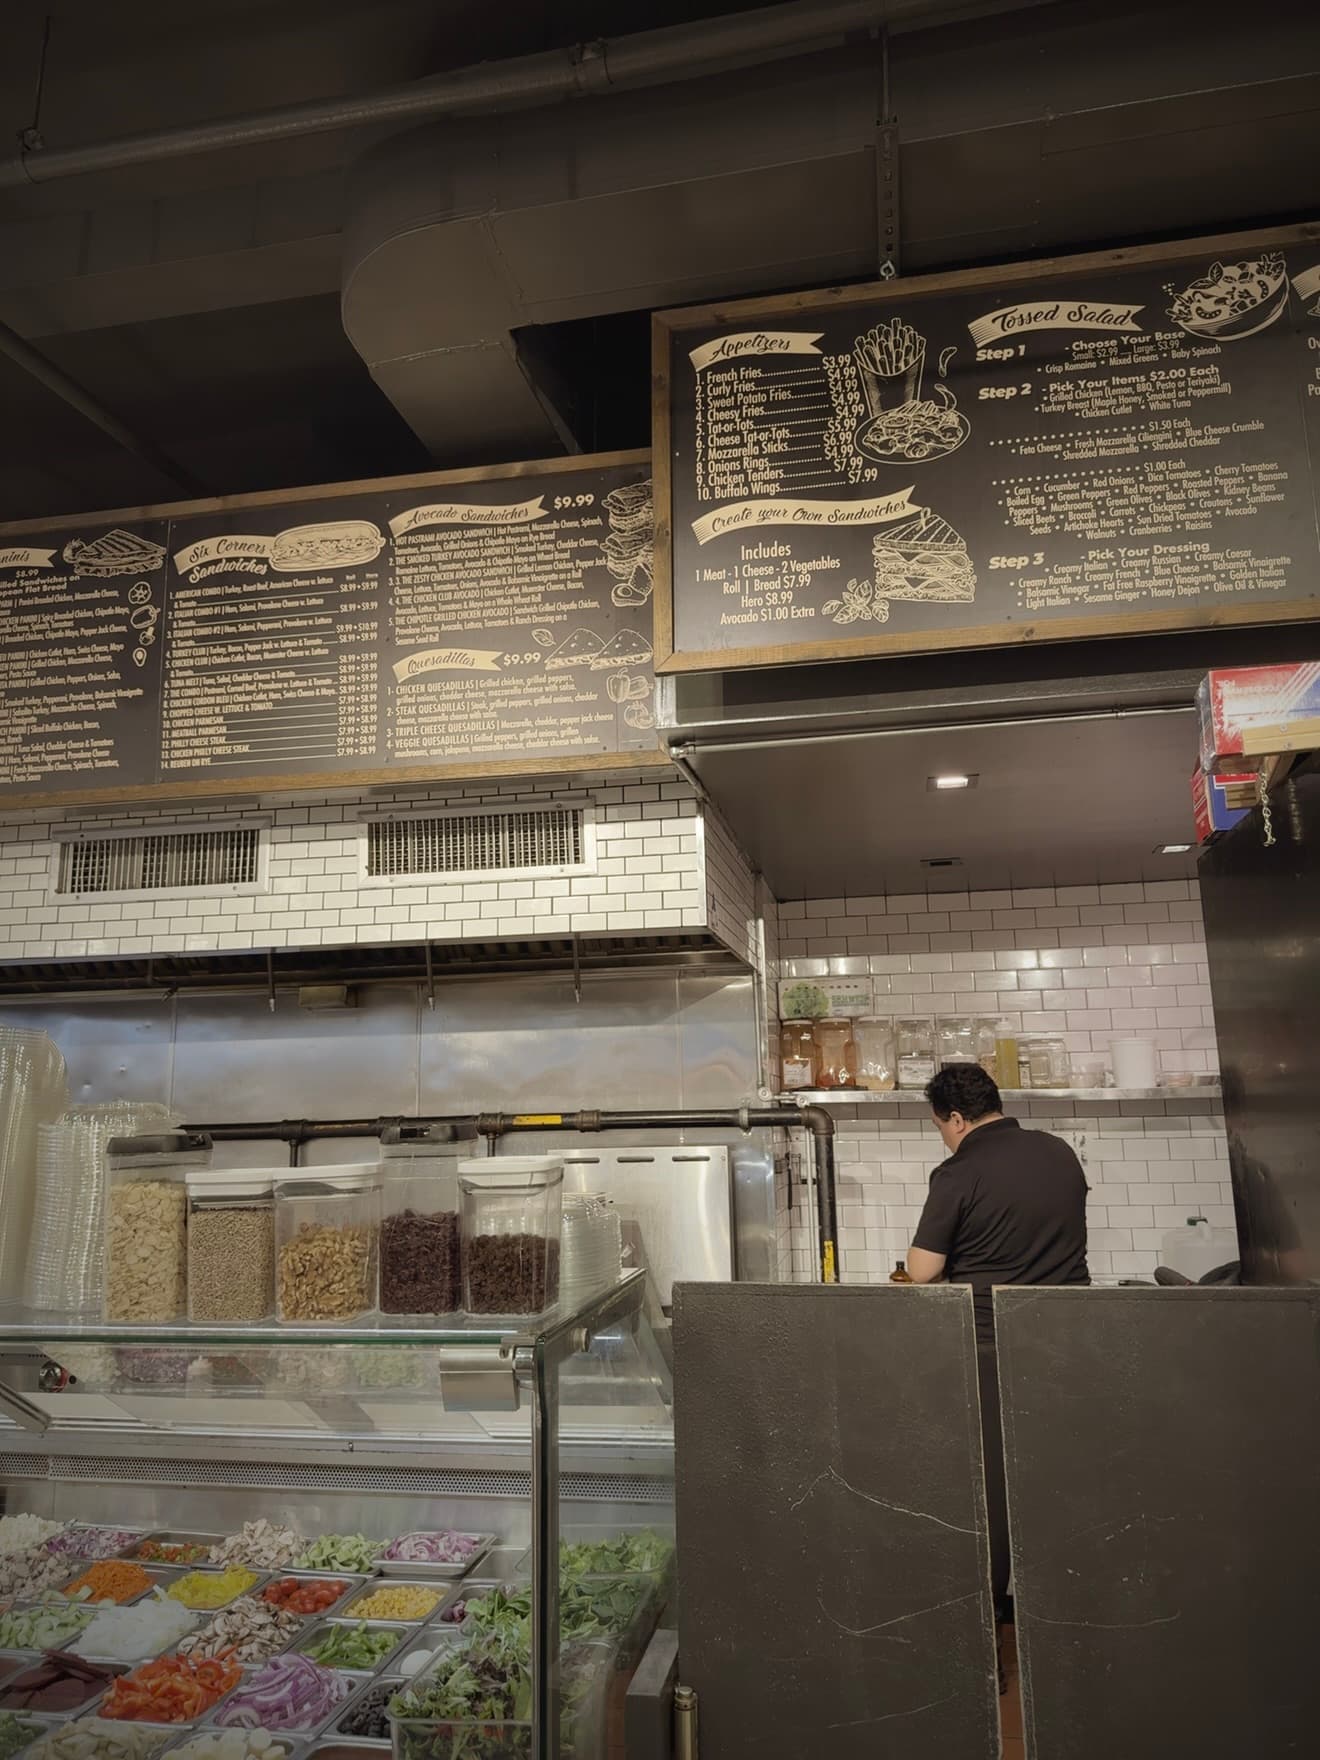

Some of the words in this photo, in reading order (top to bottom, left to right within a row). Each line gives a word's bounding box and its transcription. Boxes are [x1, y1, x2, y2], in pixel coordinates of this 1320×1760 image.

[991, 304, 1060, 332] Tossed
[1067, 304, 1132, 326] Salad
[709, 334, 790, 362] Appetizers
[1072, 335, 1117, 351] Choose
[1121, 331, 1151, 345] Your
[1155, 326, 1186, 342] Base
[1097, 345, 1118, 360] $2.99
[1158, 338, 1179, 353] $3.99
[976, 347, 1014, 363] Step
[1017, 344, 1026, 358] 1
[1045, 363, 1063, 375] Crisp
[1065, 357, 1096, 371] Romaine
[1109, 353, 1132, 366] Mixed
[1133, 350, 1160, 363] Greens
[1171, 347, 1191, 361] Baby
[1192, 344, 1221, 359] Spinach
[696, 372, 704, 385] 1.
[707, 368, 738, 383] French
[740, 366, 763, 379] Fries
[822, 353, 850, 370] $3.99
[1050, 380, 1074, 394] Pick
[1077, 376, 1108, 391] Your
[1112, 371, 1146, 386] Items
[1149, 367, 1186, 384] $2.00
[1190, 363, 1219, 377] Each
[696, 385, 704, 398] 2.
[707, 381, 731, 399] Curly
[734, 378, 757, 393] Fries
[827, 365, 857, 384] $4.99
[978, 385, 1016, 401] Step
[1019, 383, 1032, 397] 2
[696, 396, 704, 410] 3.
[707, 393, 736, 409] Sweet
[738, 389, 767, 405] Potato
[769, 386, 793, 401] Fries
[829, 378, 858, 396] $4.99
[696, 409, 704, 422] 4.
[707, 405, 740, 424] Cheesy
[743, 402, 766, 417] Fries
[831, 391, 861, 409] $4.99
[1081, 404, 1111, 418] Chicken
[1111, 402, 1133, 415] Cutlet
[1149, 398, 1172, 411] White
[1172, 396, 1191, 408] Tuna
[696, 424, 704, 436] 5.
[834, 404, 864, 422] $4.99
[1148, 419, 1170, 434] $1.50
[1171, 417, 1192, 429] Each
[696, 435, 705, 448] 6.
[708, 430, 740, 447] Cheese
[827, 416, 857, 435] $5.99
[1185, 427, 1202, 439] Blue
[1203, 424, 1230, 437] Cheese
[696, 448, 705, 462] 7.
[708, 441, 759, 460] Mozzarella
[761, 437, 789, 454] Sticks
[822, 429, 852, 447] $6.99
[696, 461, 705, 475] 8.
[708, 456, 740, 473] Onions
[743, 453, 770, 471] Rings
[824, 442, 854, 461] $4.99
[1144, 460, 1167, 474] $1.00
[1167, 458, 1186, 470] Each
[696, 474, 705, 487] 9.
[708, 469, 745, 486] Chicken
[747, 464, 785, 481] Tenders
[833, 455, 864, 472] $7.99
[1093, 477, 1107, 488] Red
[1109, 475, 1136, 486] Onions
[1214, 464, 1239, 479] Cherry
[1241, 461, 1278, 473] Tomatoes
[697, 487, 712, 501] 10.
[715, 483, 748, 498] Buffalo
[751, 480, 781, 496] Wings
[848, 468, 877, 485] $7.99
[554, 494, 595, 511] $9.99
[405, 507, 458, 528] Avocado
[461, 507, 529, 522] Sandwiches
[711, 506, 752, 533] Create
[756, 508, 789, 523] your
[792, 508, 823, 522] Own
[827, 500, 906, 524] Sandwiches
[1086, 528, 1116, 540] Walnuts
[1129, 523, 1172, 536] Cranberries
[1185, 518, 1212, 531] Raisins
[189, 545, 209, 564] Six
[216, 538, 266, 555] Corners
[741, 541, 791, 560] Includes
[989, 555, 1029, 570] Step
[1032, 551, 1045, 566] 3
[1088, 548, 1114, 561] Pick
[1118, 546, 1149, 558] Your
[1153, 539, 1210, 559] Dressing
[15, 569, 39, 578] $8.99
[188, 557, 269, 584] Sandwiches
[703, 568, 726, 581] Meat
[742, 563, 774, 577] Cheese
[782, 561, 788, 573] 2
[790, 555, 840, 576] Vegetables
[19, 575, 67, 587] Sandwiches
[25, 584, 41, 593] Flat
[42, 583, 68, 592] Bread
[723, 580, 740, 595] Roll
[754, 576, 781, 591] Bread
[783, 572, 811, 589] $7.99
[1214, 580, 1234, 592] Olive
[1235, 579, 1247, 590] Oil
[1256, 575, 1286, 590] Vinegar
[741, 594, 763, 608] Hero
[765, 590, 793, 606] $8.99
[395, 614, 406, 625] THE
[407, 613, 432, 624] CHIPOTLE
[433, 611, 456, 622] GRILLED
[457, 608, 481, 619] CHICKEN
[482, 607, 509, 617] AVOCADO
[720, 609, 758, 625] Avocado
[761, 607, 788, 622] $1.00
[791, 605, 814, 618] Extra
[407, 651, 477, 675] Quesadillas
[503, 652, 541, 666] $9.99
[395, 684, 426, 695] CHICKEN
[427, 680, 474, 692] QUESADILLAS
[395, 705, 417, 717] STEAK
[419, 701, 465, 714] QUESADILLAS
[395, 726, 418, 737] TRIPLE
[420, 724, 446, 735] CHEESE
[448, 720, 495, 733] QUESADILLAS
[395, 738, 420, 750] VEGGIE
[422, 734, 469, 747] QUESADILLAS
